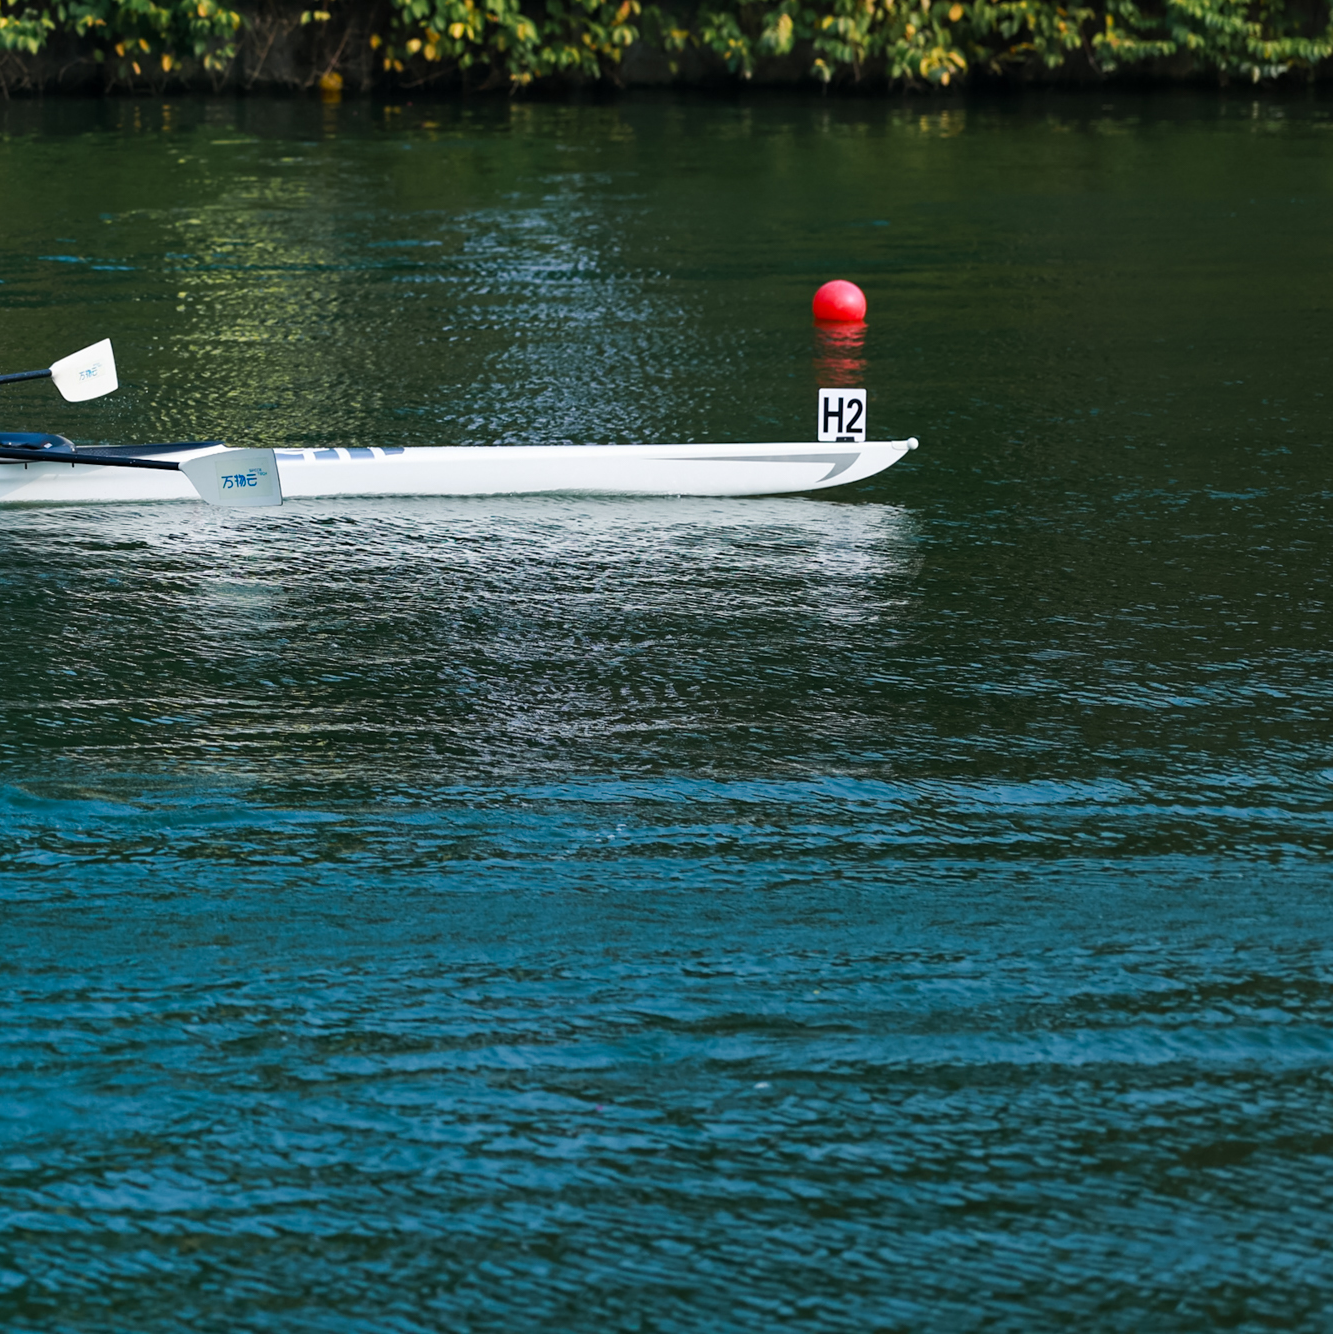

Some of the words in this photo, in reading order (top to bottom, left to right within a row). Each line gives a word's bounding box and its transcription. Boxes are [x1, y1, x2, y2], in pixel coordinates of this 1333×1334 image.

[823, 397, 863, 433] H2
[221, 473, 258, 489] 万物云
